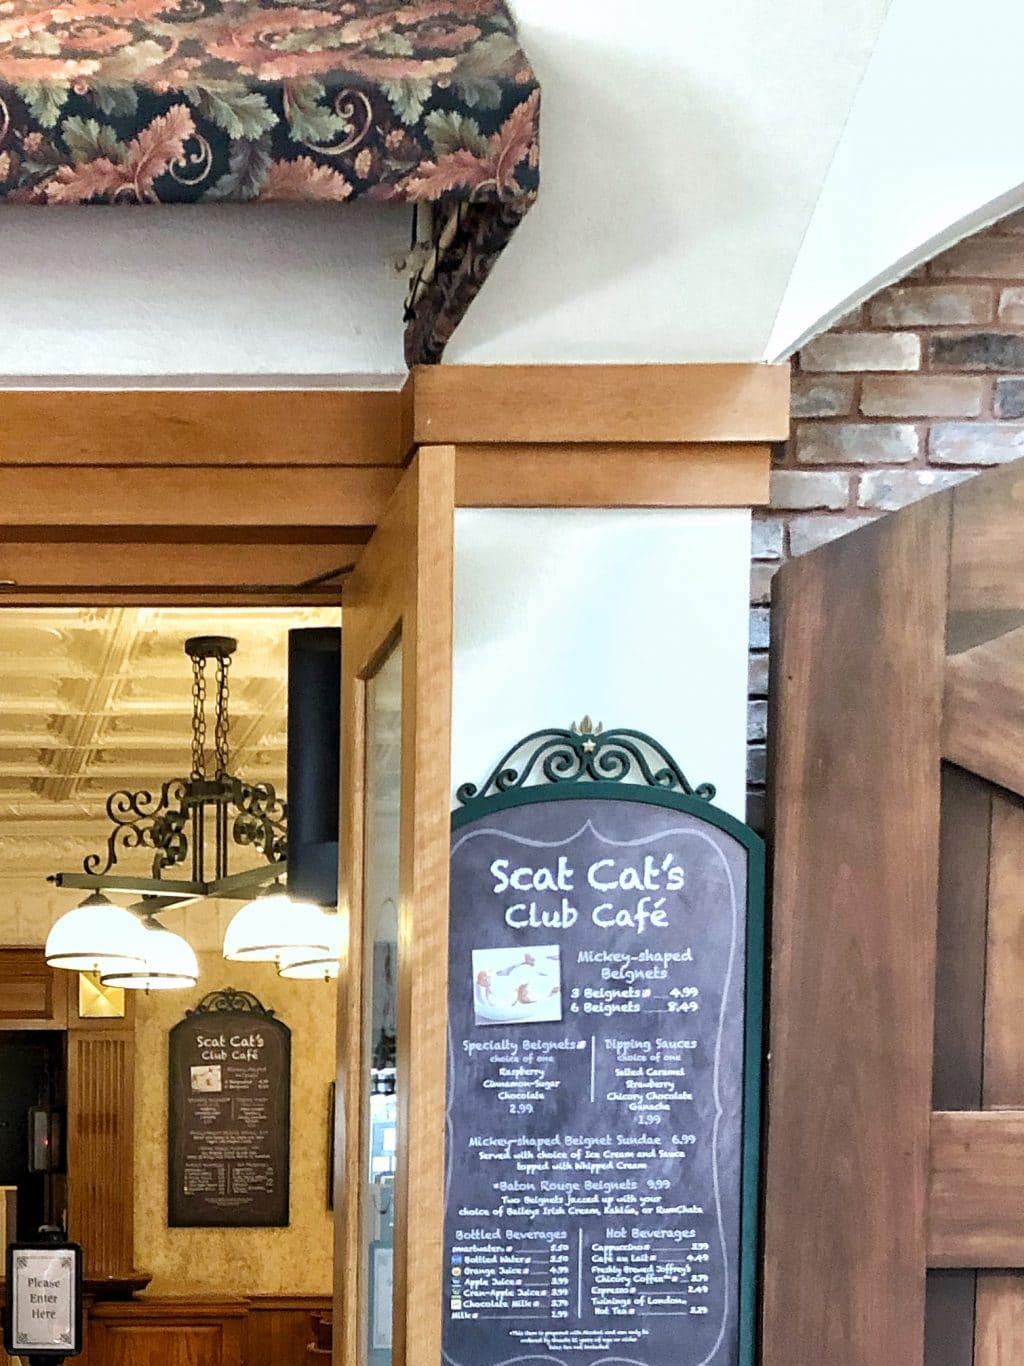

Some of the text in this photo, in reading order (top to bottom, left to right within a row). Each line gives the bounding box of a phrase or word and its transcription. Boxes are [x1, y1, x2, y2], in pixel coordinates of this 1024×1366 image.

[490, 853, 684, 893] Scat Cat's
[505, 897, 669, 934] Club Café
[577, 948, 693, 969] Mickey-shaped
[601, 966, 667, 984] Beignets
[571, 987, 699, 1001] 3 Beignets 4.99
[571, 1001, 699, 1016] 6 Beignets 8.49
[196, 1034, 226, 1048] Scat
[463, 1038, 576, 1056] Specialty Beignets
[605, 1038, 697, 1055] Dipping Sauces
[201, 1049, 227, 1060] Club
[522, 1053, 533, 1063] of
[650, 1052, 660, 1062] of
[615, 1067, 685, 1076] Salted Caramel
[497, 1091, 544, 1100] Chocolate
[509, 1104, 533, 1114] 2.99
[468, 1133, 696, 1152] Mickey-shaped Beignet Sundae 6.99
[513, 1150, 534, 1159] with
[537, 1150, 567, 1159] choice
[570, 1149, 582, 1160] of
[636, 1149, 656, 1158] and
[552, 1162, 572, 1170] with
[616, 1161, 647, 1170] Cream
[499, 1180, 535, 1191] Baton
[540, 1180, 580, 1194] Rouge
[584, 1179, 637, 1194] Beignets
[501, 1196, 521, 1204] Two
[524, 1195, 564, 1206] Beignets
[616, 1195, 637, 1203] with
[458, 1207, 490, 1216] choice
[493, 1205, 504, 1217] of
[542, 1207, 566, 1215] Irish
[456, 1228, 568, 1243] Bottled Beverages
[606, 1227, 696, 1242] Hot Beverages
[464, 1267, 496, 1277] Orange
[27, 1277, 61, 1288] Please
[464, 1278, 489, 1290] Apple
[30, 1293, 58, 1304] Enter
[32, 1309, 56, 1319] Here
